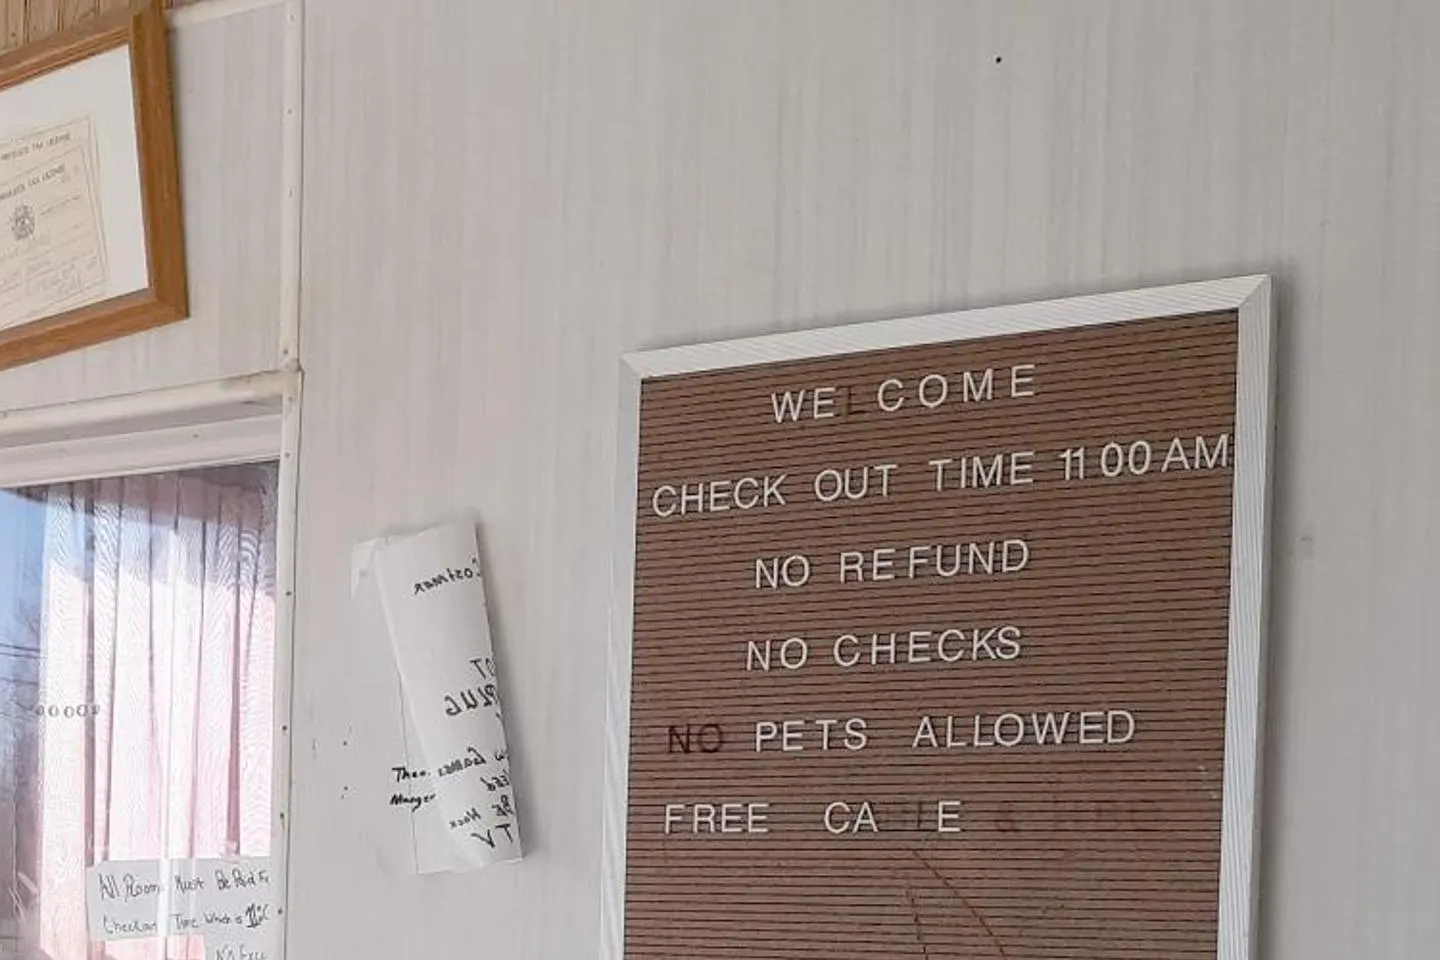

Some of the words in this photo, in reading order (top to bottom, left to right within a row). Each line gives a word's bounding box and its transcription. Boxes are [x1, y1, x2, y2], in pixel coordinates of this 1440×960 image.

[652, 475, 786, 517] CHECK
[814, 463, 897, 502] OUT
[929, 451, 1035, 491] TIME
[1160, 433, 1229, 473] AM
[754, 554, 811, 590] NO
[840, 538, 1030, 583] REFUND
[745, 637, 809, 672] NO
[832, 626, 1022, 668] CHECKS
[755, 717, 869, 754] PETS
[912, 709, 1136, 750] ALLOWED
[664, 802, 769, 835] FREE
